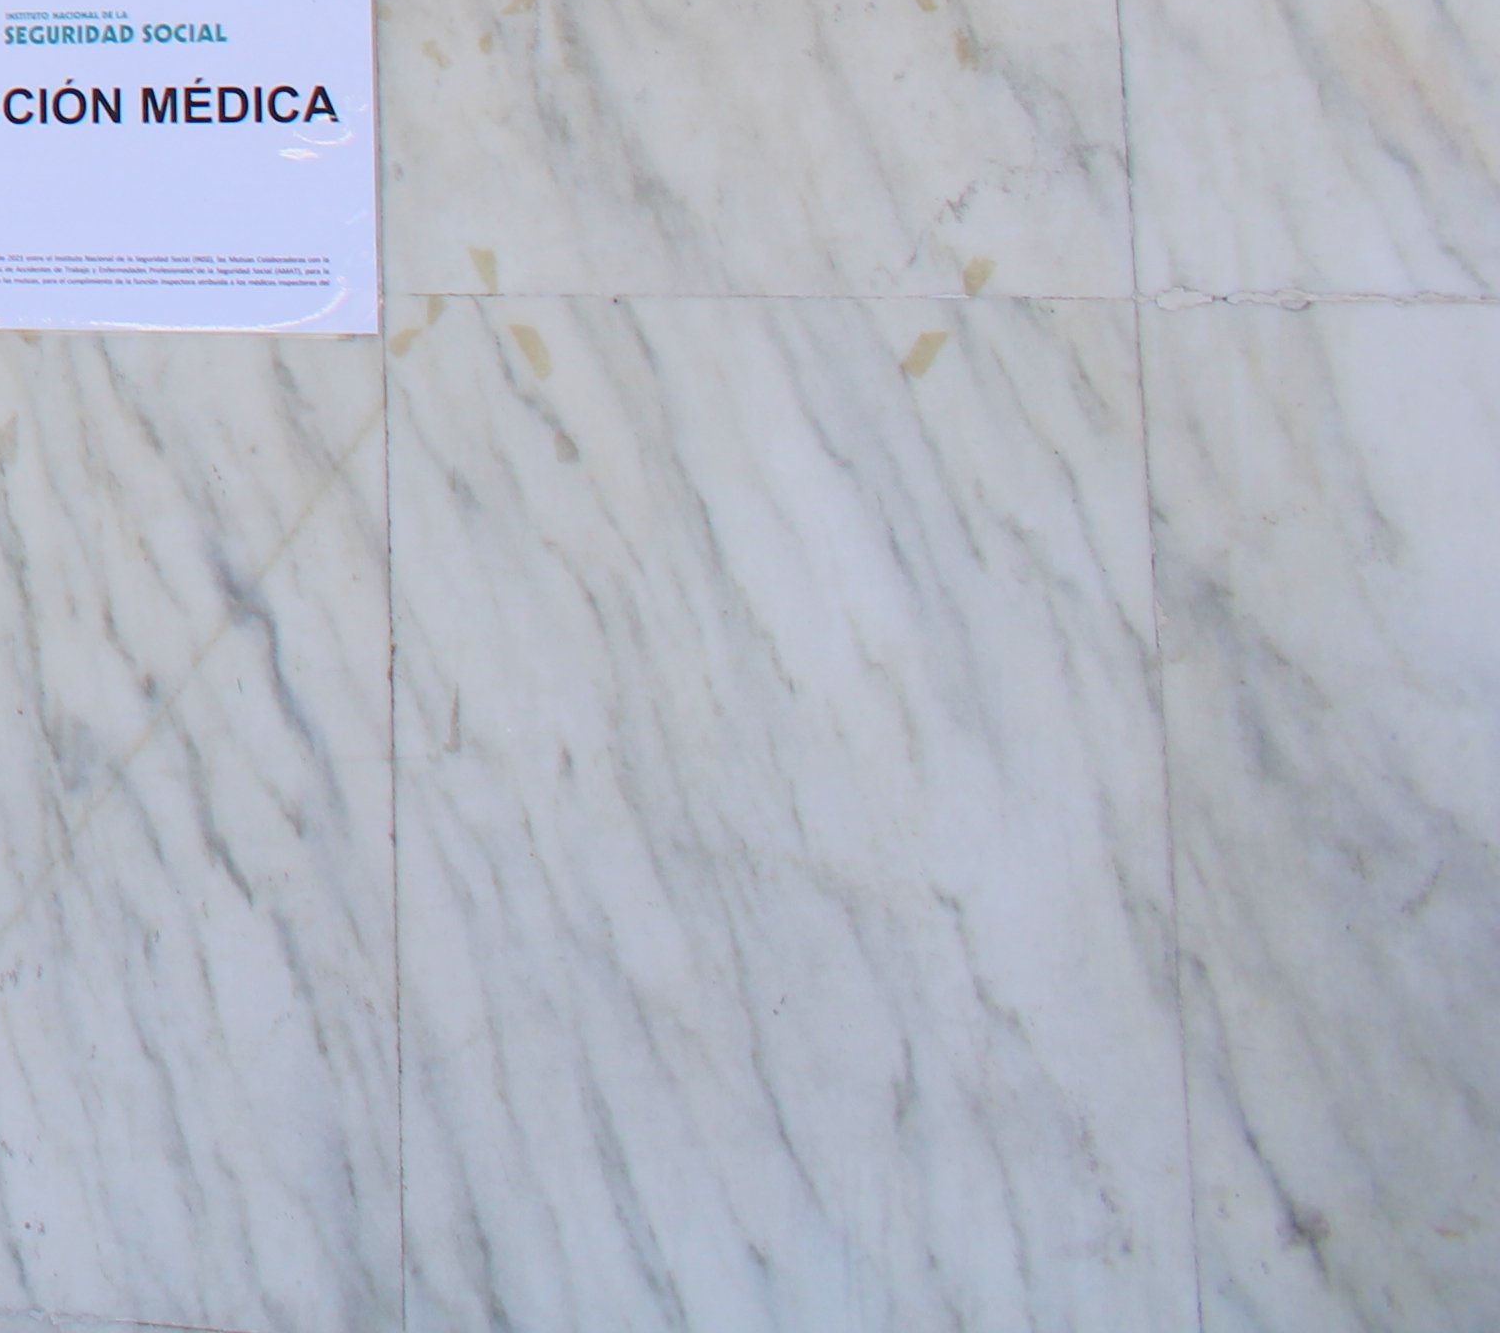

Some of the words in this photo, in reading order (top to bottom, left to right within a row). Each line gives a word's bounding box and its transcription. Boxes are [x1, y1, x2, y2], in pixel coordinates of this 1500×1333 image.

[5, 11, 49, 20] INSTITUTO
[52, 11, 99, 20] NACIONAL
[102, 11, 113, 19] DE
[115, 11, 128, 19] LA
[4, 24, 134, 45] SEGURIDAD
[142, 23, 227, 43] SOCIAL
[142, 78, 339, 123] MÉDICA
